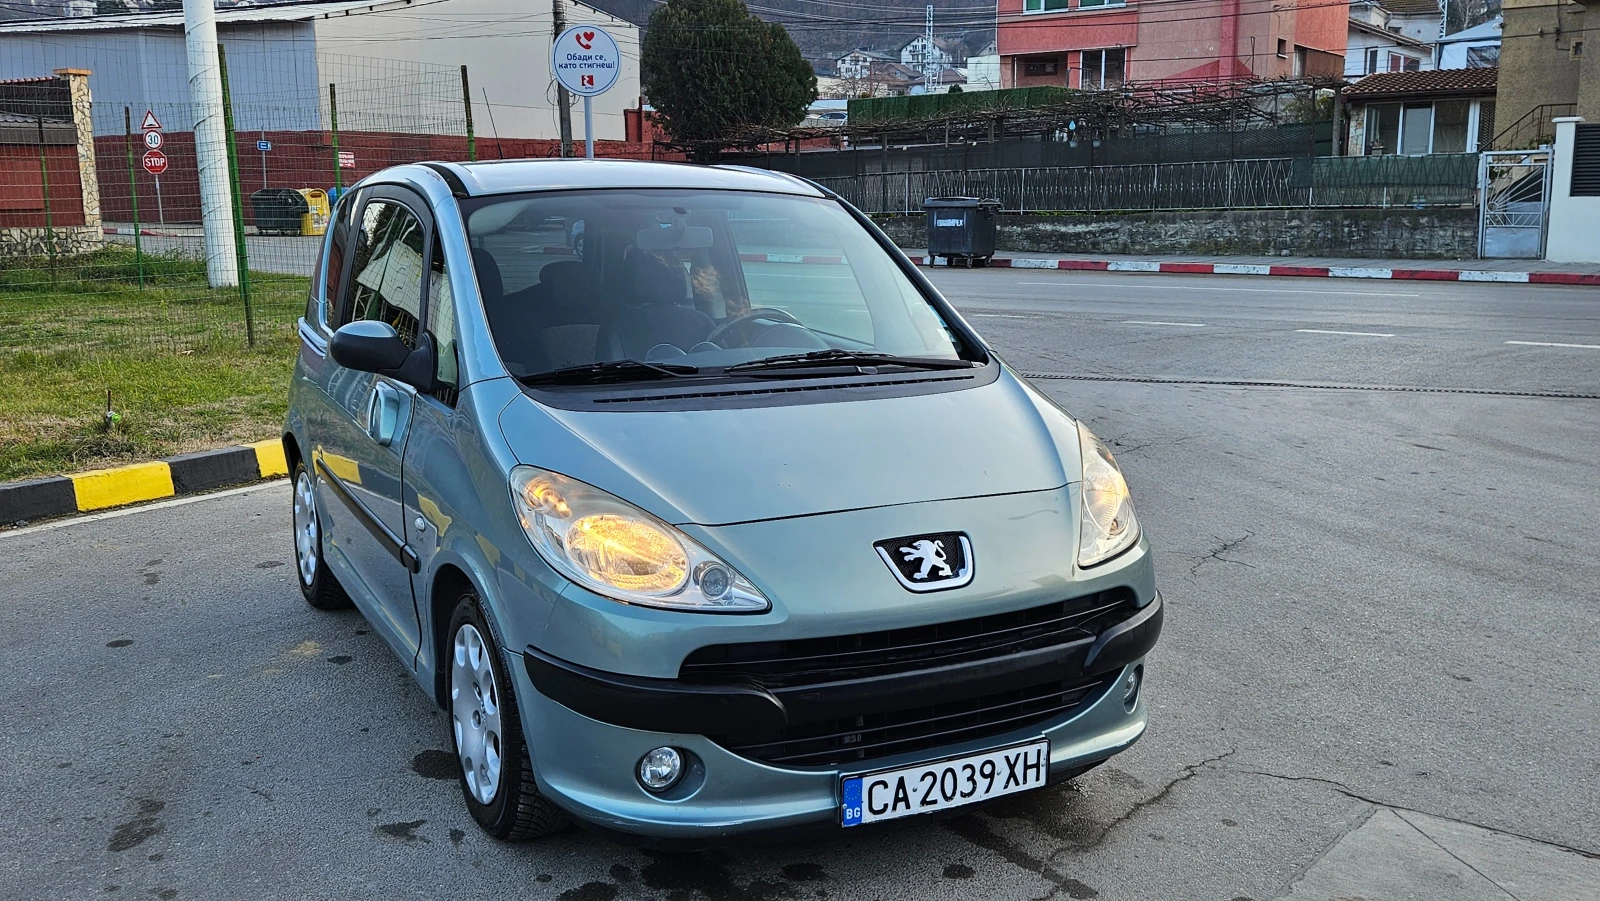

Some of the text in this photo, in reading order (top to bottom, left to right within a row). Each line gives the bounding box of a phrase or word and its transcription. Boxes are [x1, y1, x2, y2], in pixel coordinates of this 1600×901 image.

[567, 53, 592, 61] Обади
[579, 61, 615, 69] стигнеш!
[147, 134, 159, 145] 30
[145, 157, 165, 167] STOP
[867, 748, 1042, 816] CA 2039 XH
[846, 807, 861, 820] BG
